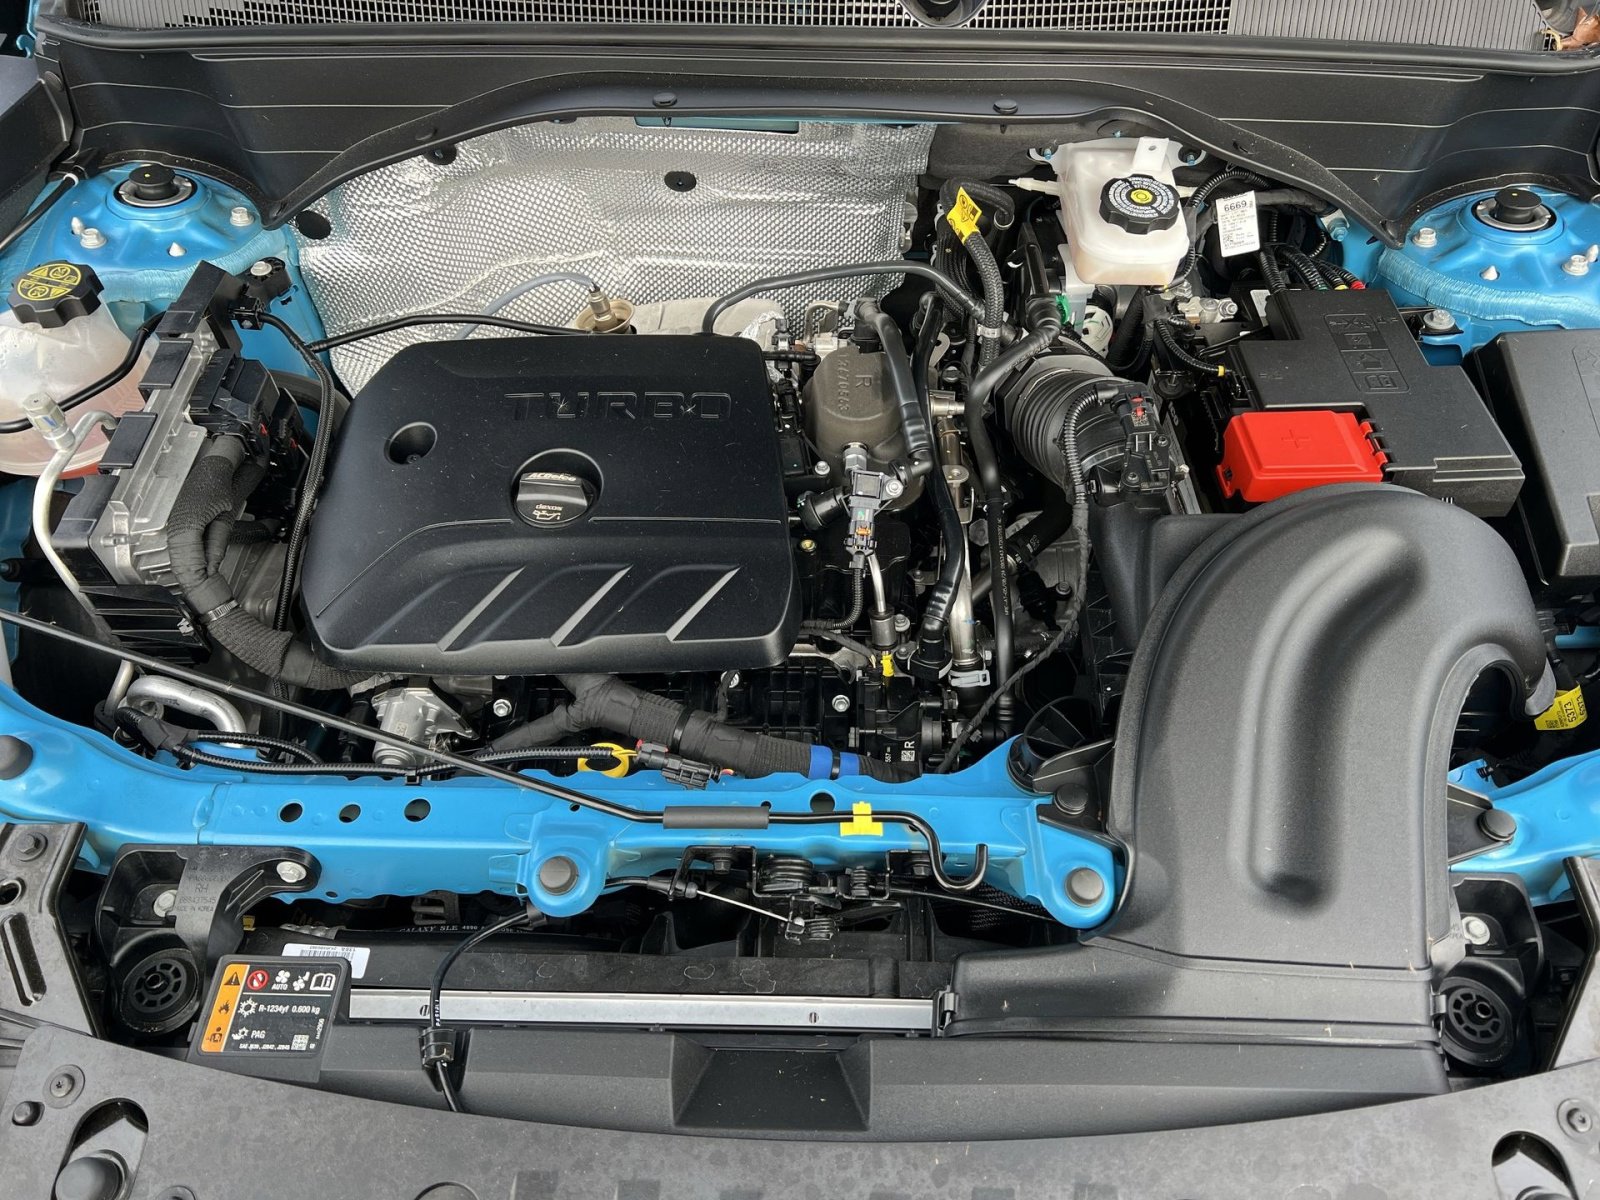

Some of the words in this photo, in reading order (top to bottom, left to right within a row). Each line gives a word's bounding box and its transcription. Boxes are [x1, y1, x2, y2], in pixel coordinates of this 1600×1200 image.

[1224, 200, 1247, 212] 6669
[856, 374, 873, 388] R
[503, 391, 732, 420] TURBO
[525, 472, 577, 482] ACDelco
[535, 503, 563, 511] dexos
[1576, 694, 1585, 716] 5373
[1563, 701, 1577, 723] 5373
[904, 741, 916, 749] R
[271, 983, 288, 991] AUTO
[258, 1005, 289, 1015] R-1234yf
[291, 1005, 311, 1013] 0.600
[311, 1005, 321, 1015] kg
[250, 1030, 266, 1039] PAG
